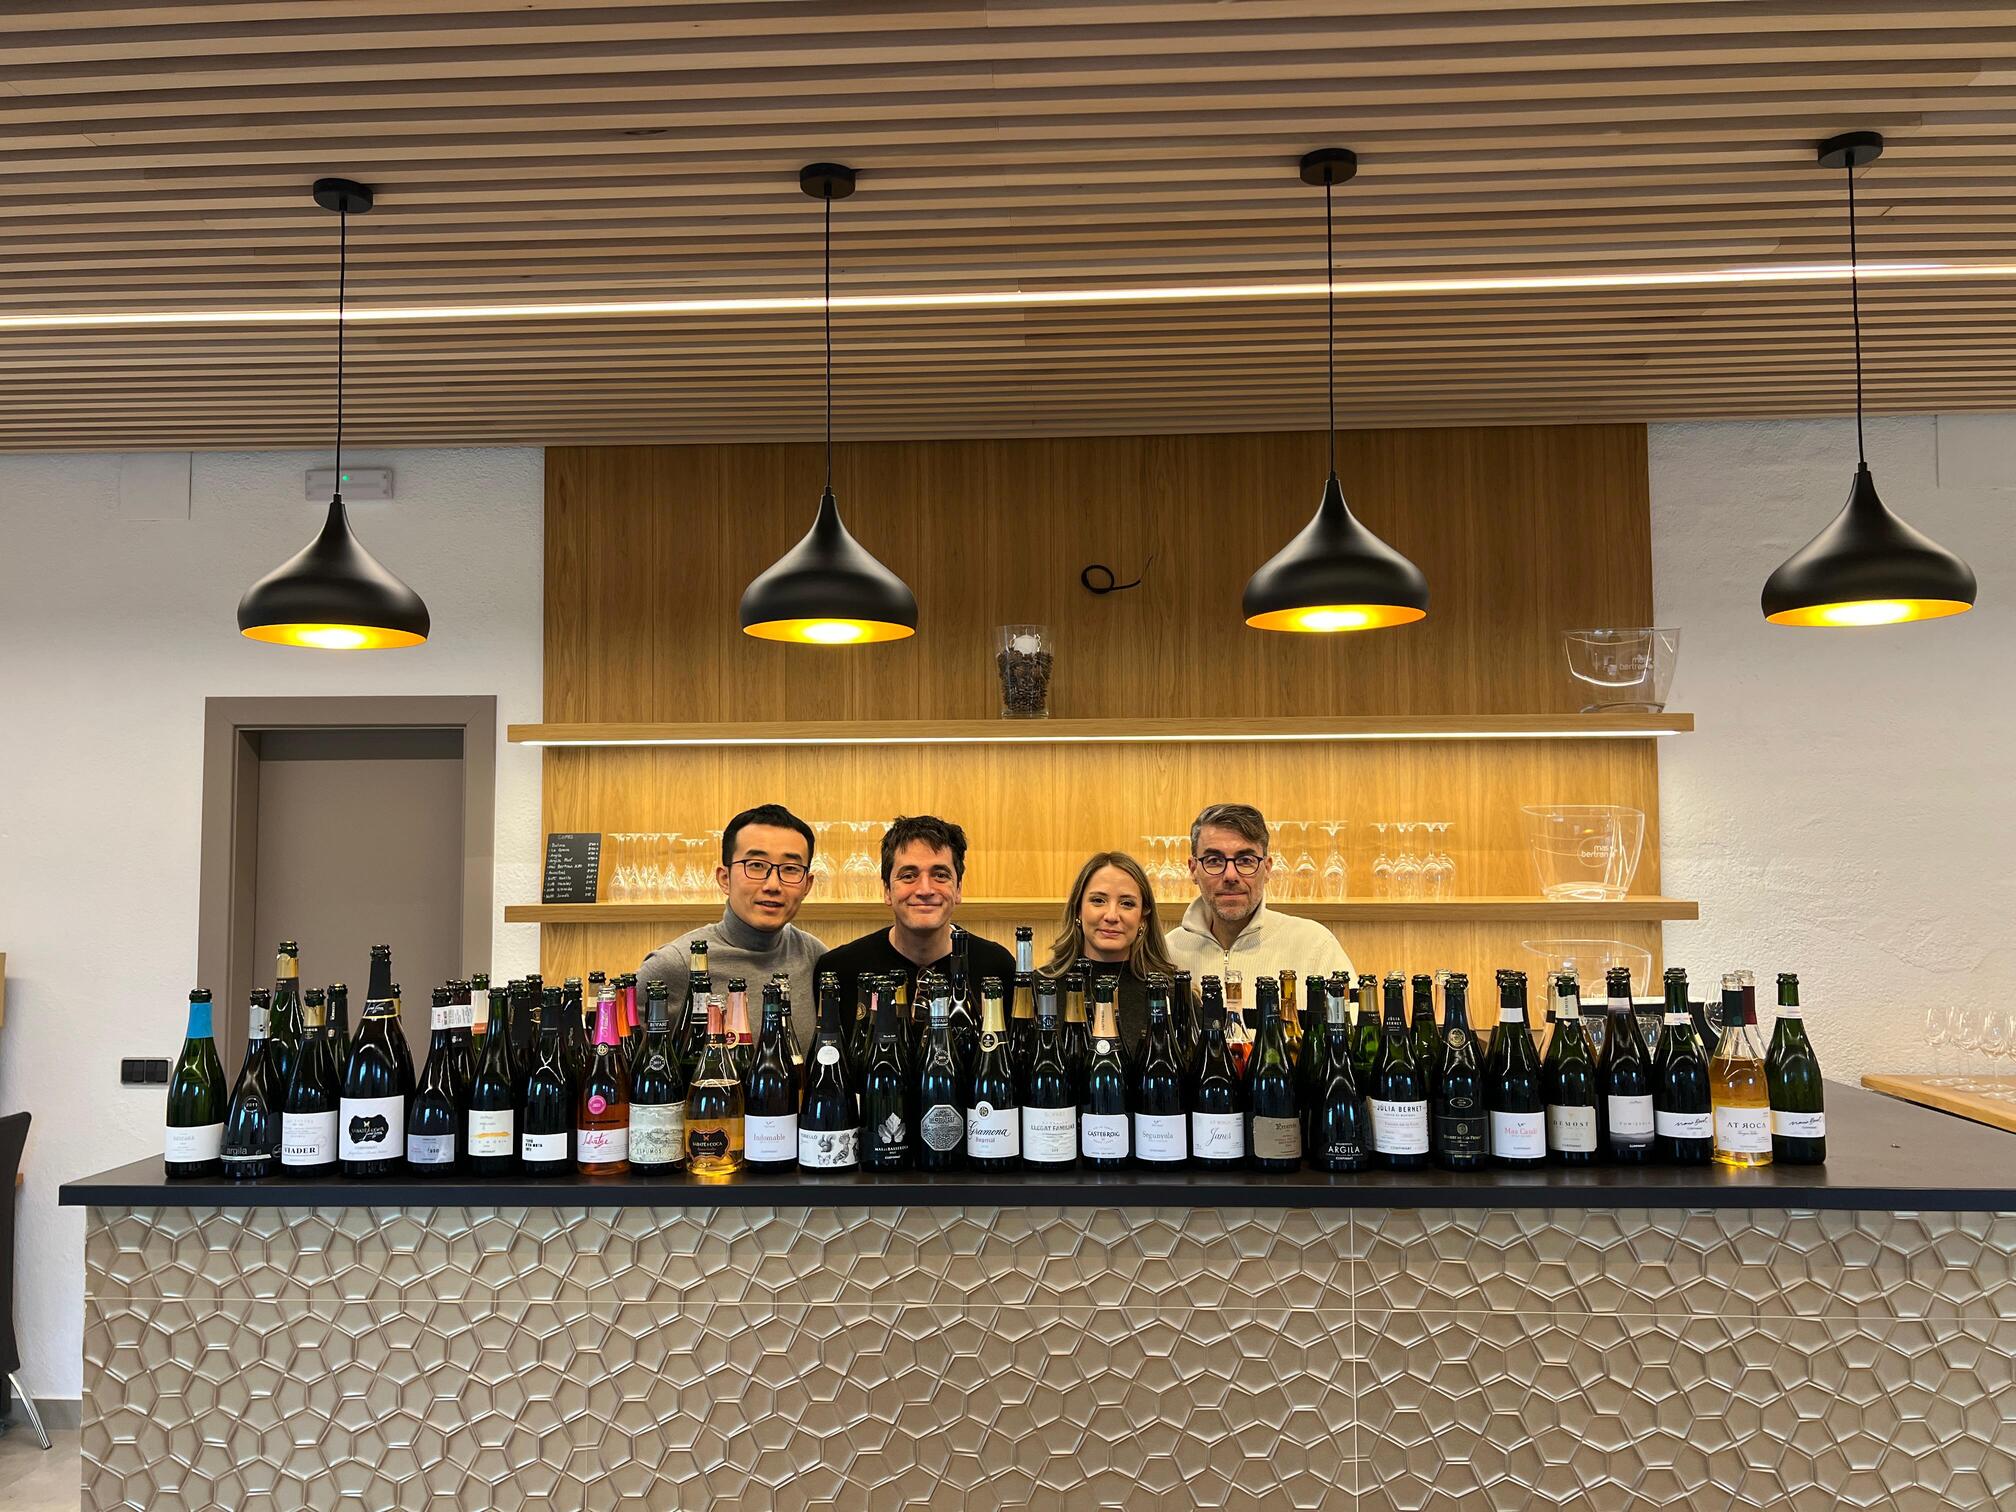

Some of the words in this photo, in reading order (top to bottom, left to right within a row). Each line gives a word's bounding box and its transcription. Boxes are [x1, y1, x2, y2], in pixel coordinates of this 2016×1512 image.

[1581, 850, 1609, 858] bertran
[1377, 1104, 1396, 1112] JÚLIA
[1399, 1105, 1422, 1113] BERNET
[967, 1119, 1012, 1140] Gramona
[752, 1133, 786, 1141] Indomable
[225, 1146, 248, 1156] argila
[1327, 1145, 1361, 1154] ARGILA
